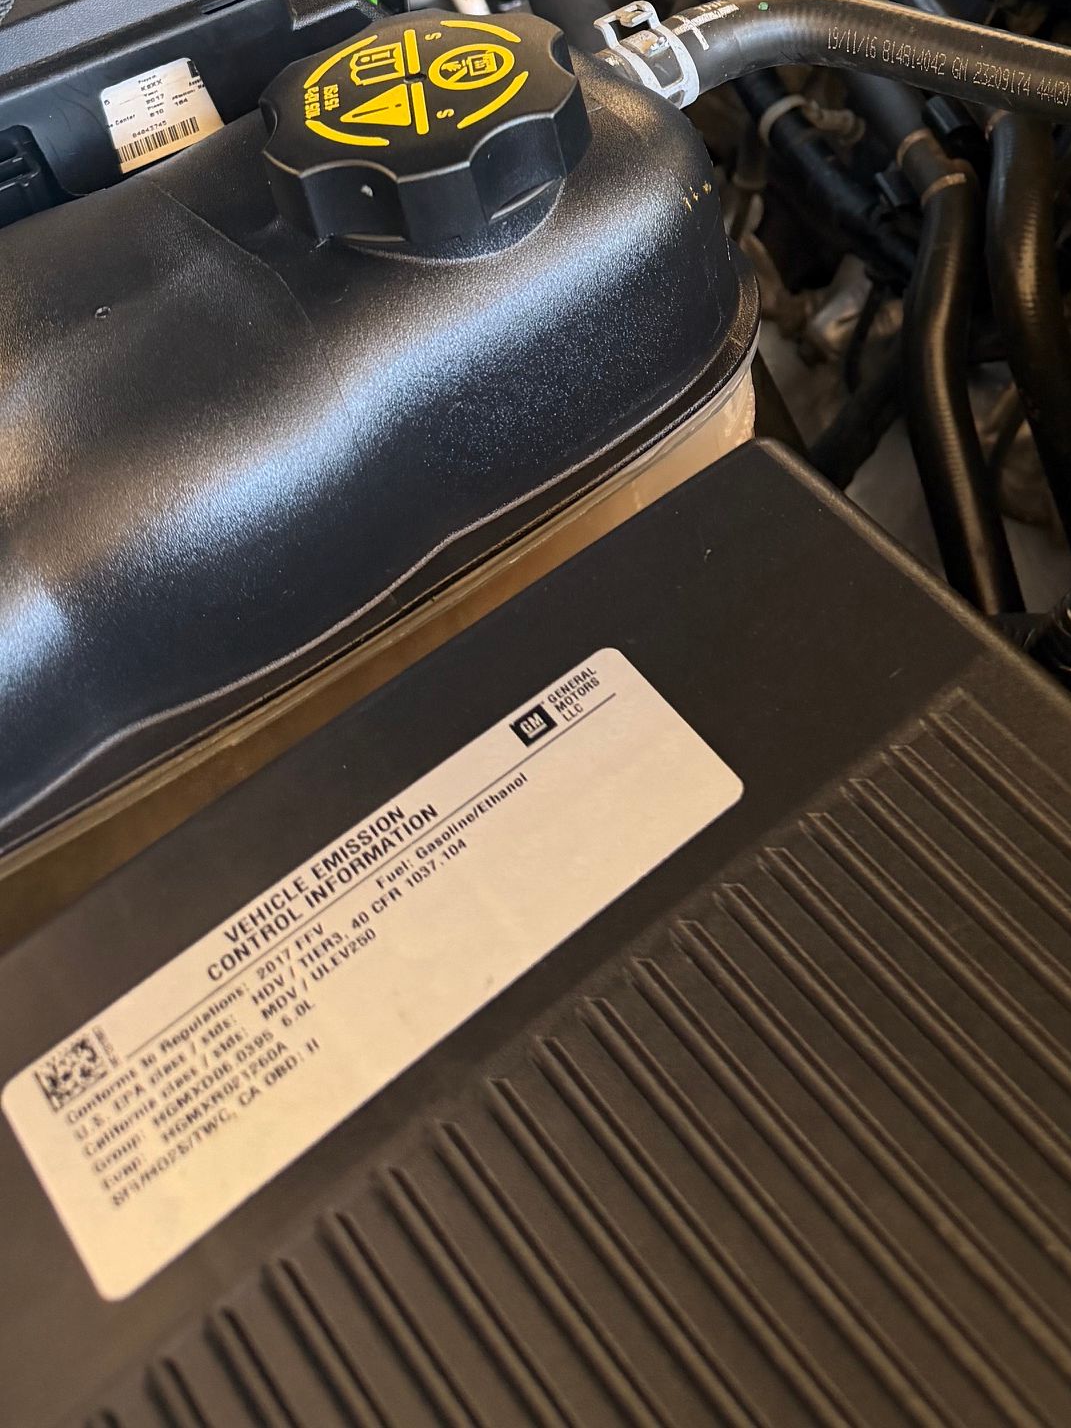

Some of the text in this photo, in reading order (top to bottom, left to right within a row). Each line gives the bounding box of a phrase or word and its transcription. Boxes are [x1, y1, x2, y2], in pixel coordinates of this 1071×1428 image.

[826, 26, 878, 60] 19/11/16
[545, 664, 597, 704] GENERAL
[553, 675, 601, 713] MOTORS
[561, 702, 585, 722] LLC
[374, 771, 528, 890] Fuel: Gasoline/Ethanol
[204, 802, 439, 983] CONTROL INFORMATION
[222, 804, 406, 946] VEHICLE EMISSION
[112, 1081, 145, 1112] EPA
[147, 1050, 186, 1085] class
[250, 972, 287, 1005] HDV
[348, 909, 370, 931] 40
[369, 885, 402, 914] CFR
[404, 836, 468, 889] 1037.104
[279, 995, 315, 1028] 6.0L
[65, 922, 326, 1125] Conforms to Regulations: 2017 FFV
[83, 1094, 159, 1158] California
[159, 1064, 198, 1099] class
[259, 985, 299, 1021] MDV
[309, 926, 377, 983] ULEV250
[236, 1082, 262, 1108] CA
